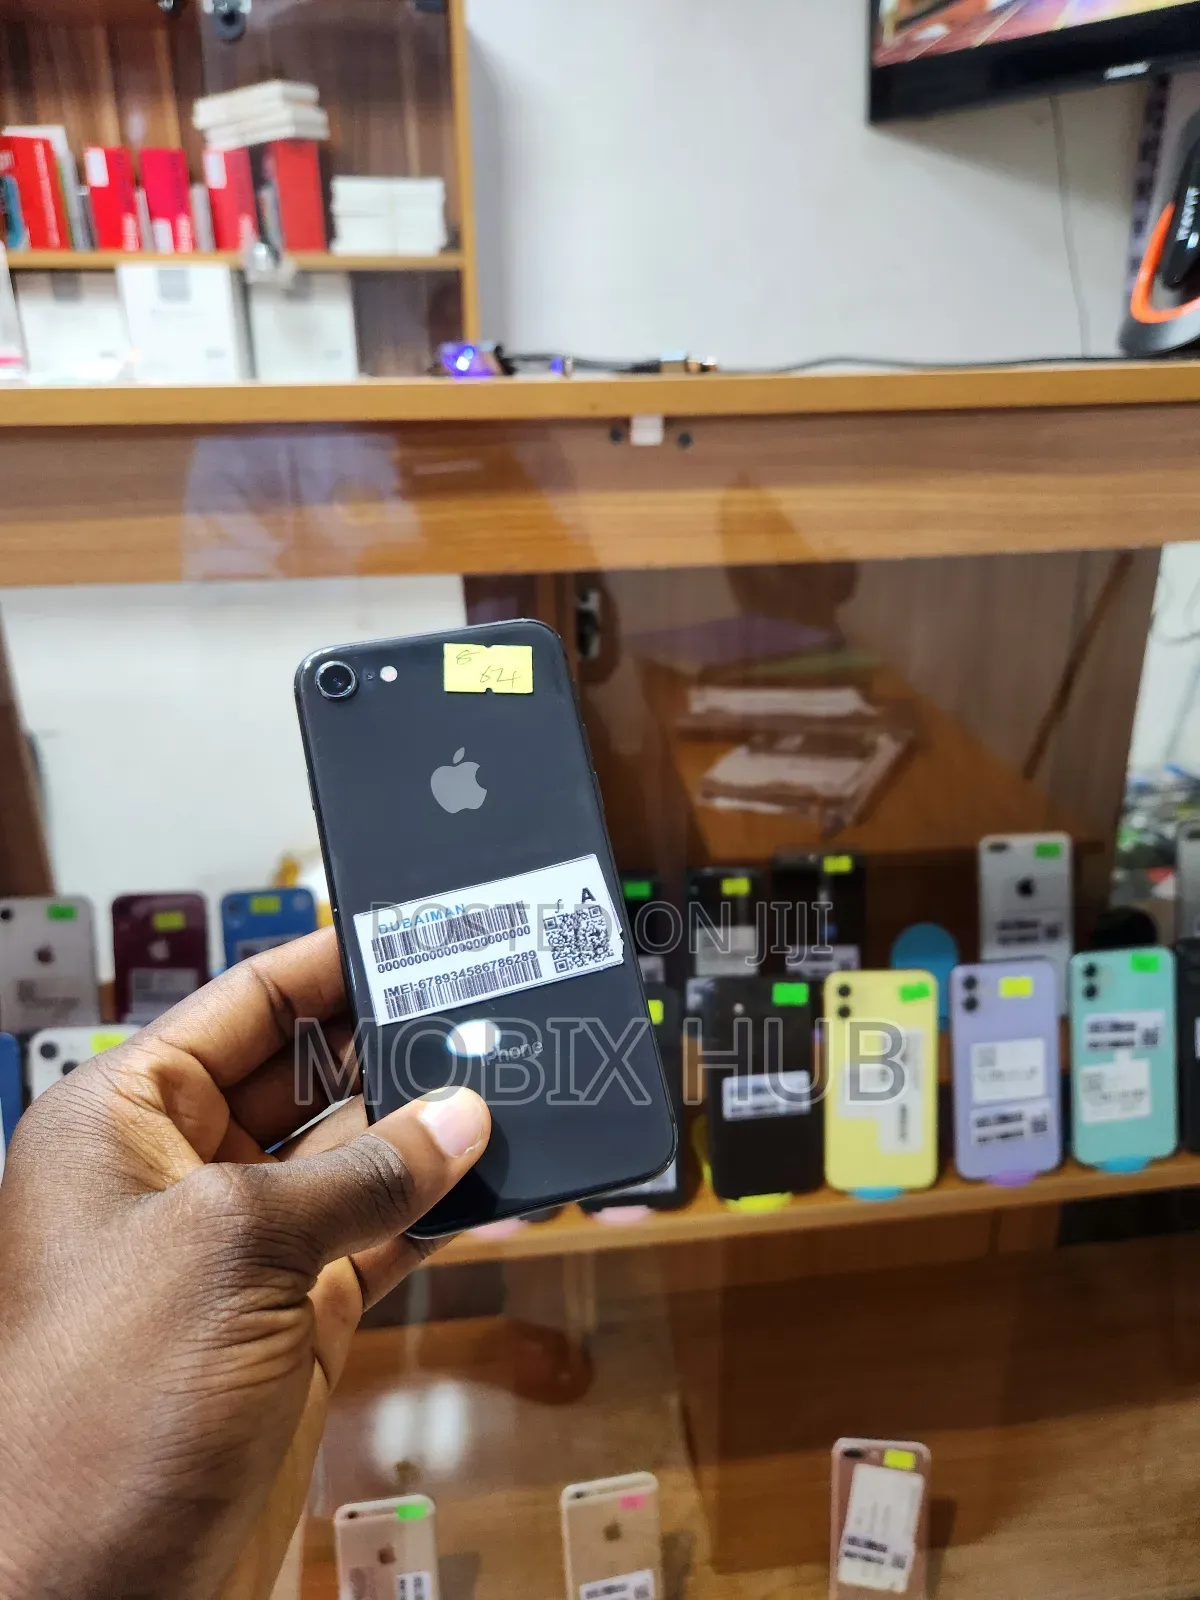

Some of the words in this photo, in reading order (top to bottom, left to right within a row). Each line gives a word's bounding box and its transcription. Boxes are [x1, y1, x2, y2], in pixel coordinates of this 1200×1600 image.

[581, 887, 596, 904] A
[378, 903, 466, 935] DUBAIMAN
[383, 950, 537, 998] IMEI:678934586786289
